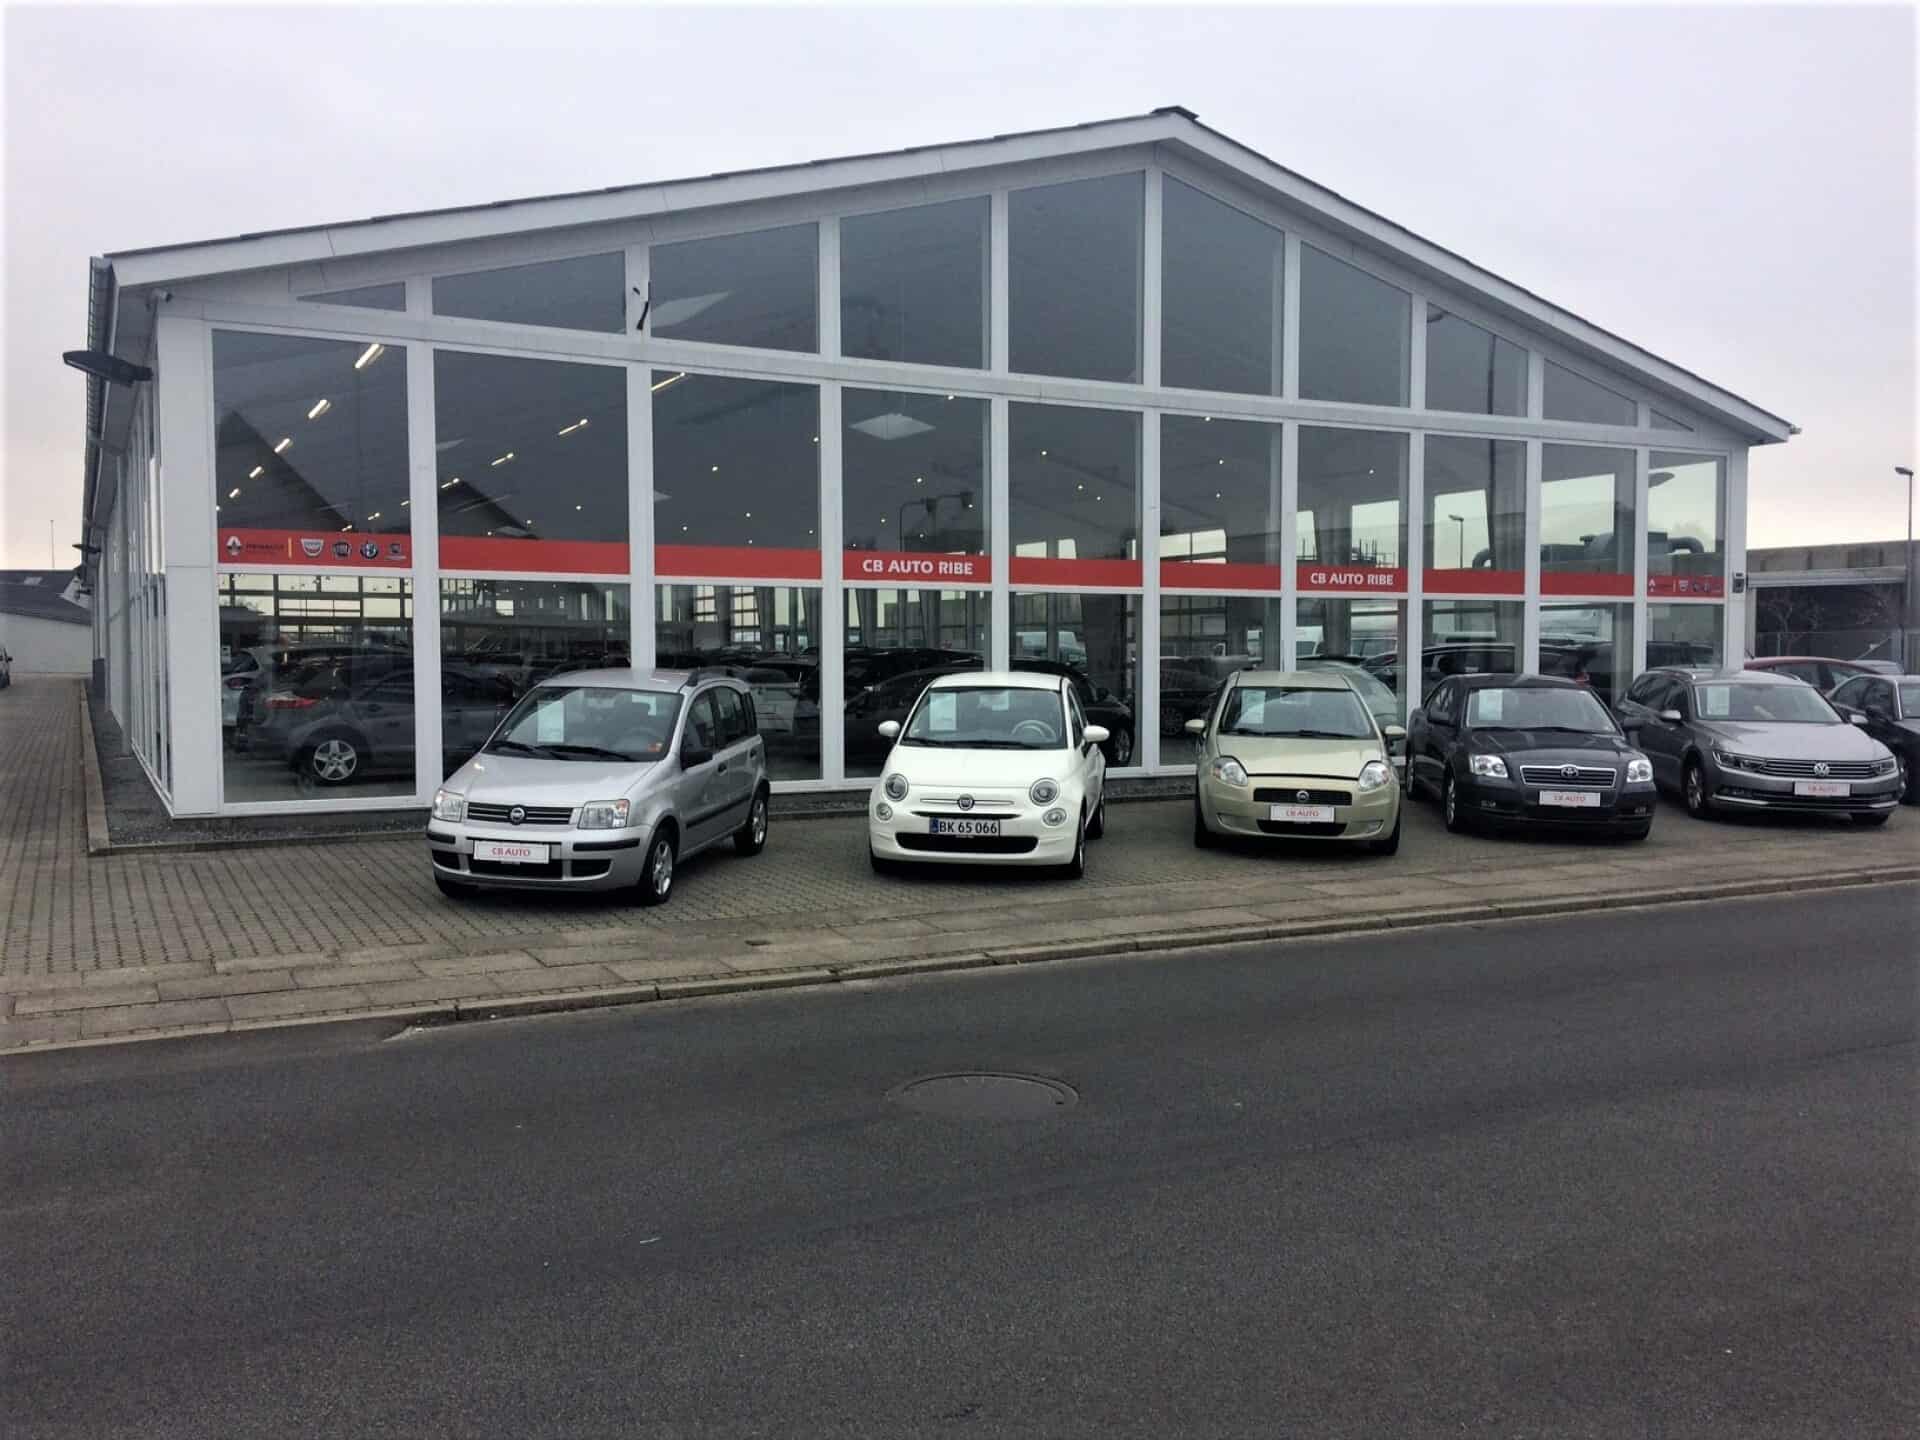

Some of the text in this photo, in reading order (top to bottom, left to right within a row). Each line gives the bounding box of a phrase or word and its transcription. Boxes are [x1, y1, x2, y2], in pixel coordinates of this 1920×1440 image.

[862, 559, 973, 575] CB AUTO RIBE
[1310, 572, 1394, 585] CB AUTO RIBE
[1297, 809, 1319, 817] AUTO
[939, 821, 997, 834] BK 65 066
[491, 847, 530, 857] CB AUTO
